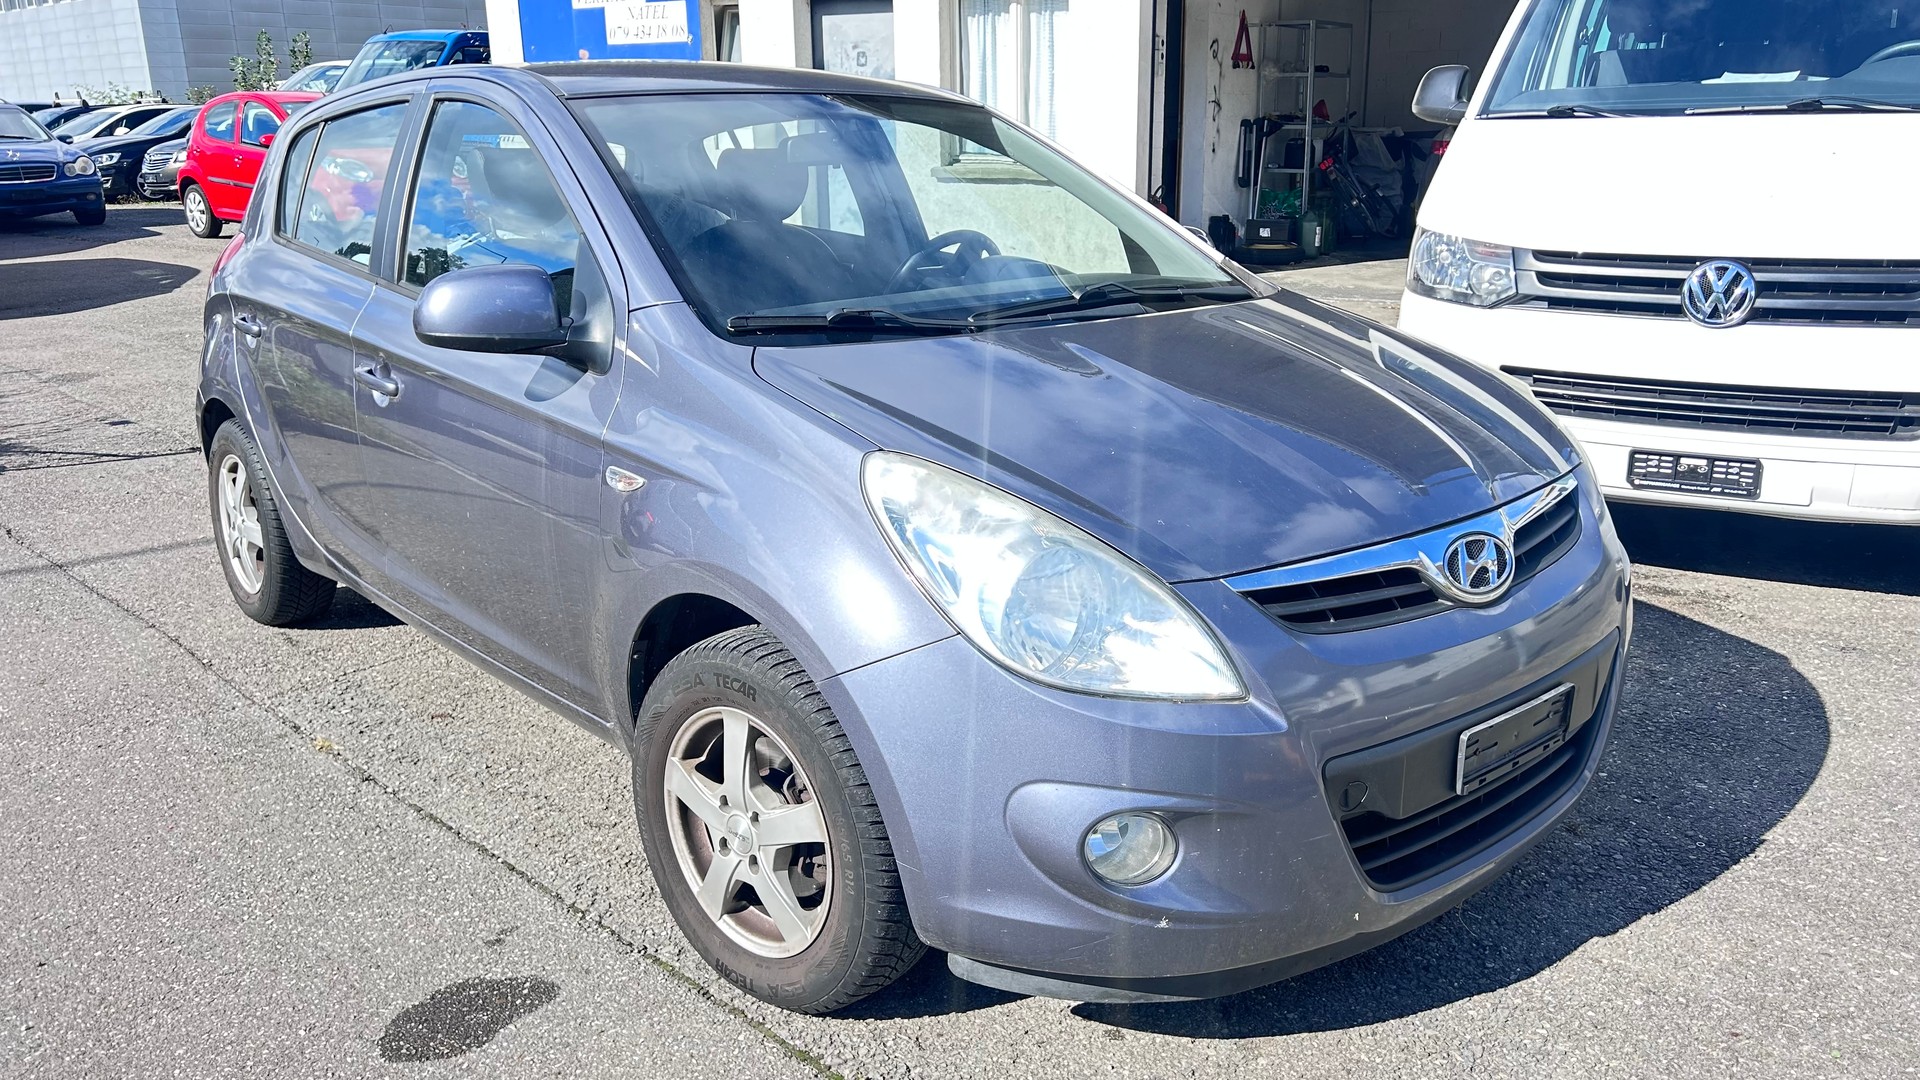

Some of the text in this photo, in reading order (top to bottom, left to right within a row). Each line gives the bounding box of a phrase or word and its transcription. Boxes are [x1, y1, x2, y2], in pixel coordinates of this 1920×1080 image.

[627, 5, 669, 20] NATEL
[634, 24, 652, 39] 434
[656, 24, 667, 39] 18
[1684, 262, 1754, 326] VW
[713, 672, 757, 703] TECAR
[715, 957, 758, 994] TECAR
